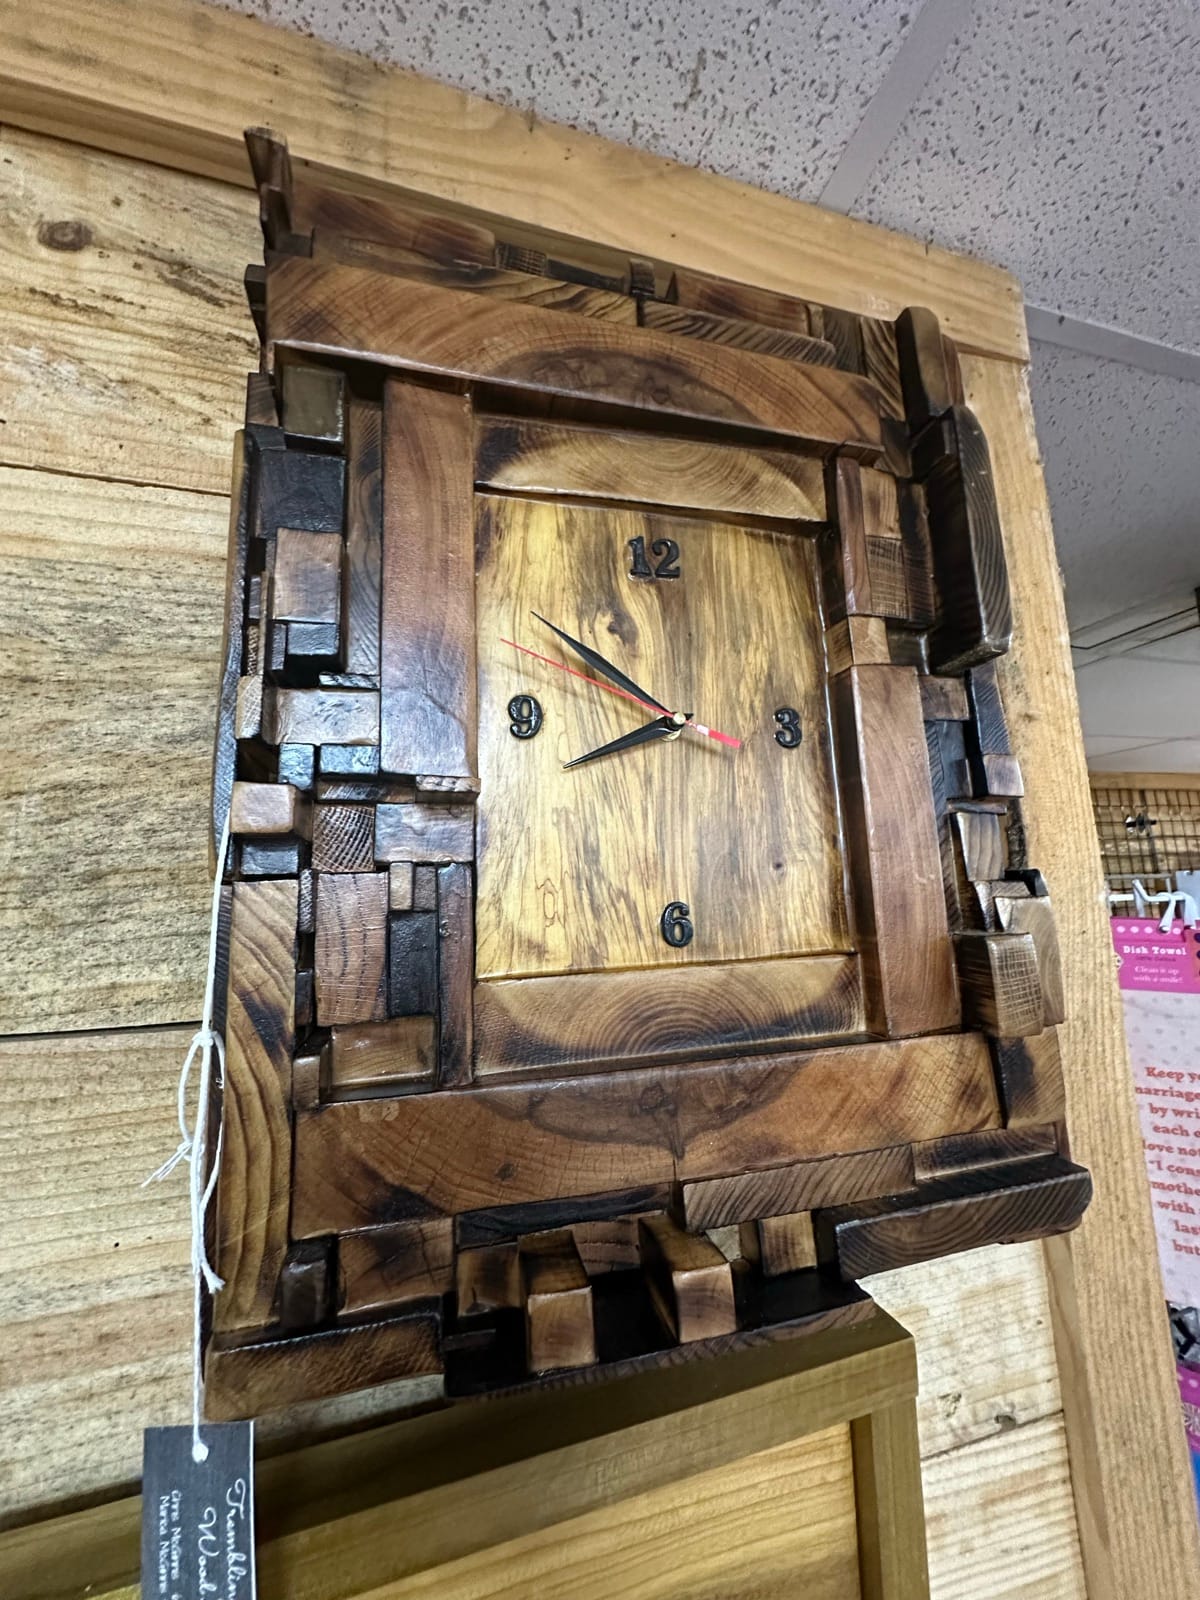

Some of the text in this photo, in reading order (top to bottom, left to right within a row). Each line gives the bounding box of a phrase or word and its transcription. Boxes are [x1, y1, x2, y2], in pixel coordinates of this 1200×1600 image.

[628, 535, 681, 579] 12
[507, 693, 543, 740] 9
[773, 707, 802, 748] 3
[660, 901, 694, 947] 6
[1123, 945, 1187, 956] Dish Towel
[1144, 1066, 1185, 1083] Keep
[1148, 1102, 1168, 1118] by
[1152, 1124, 1190, 1137] each
[1157, 1200, 1196, 1215] with
[226, 1477, 248, 1600] Tremblin
